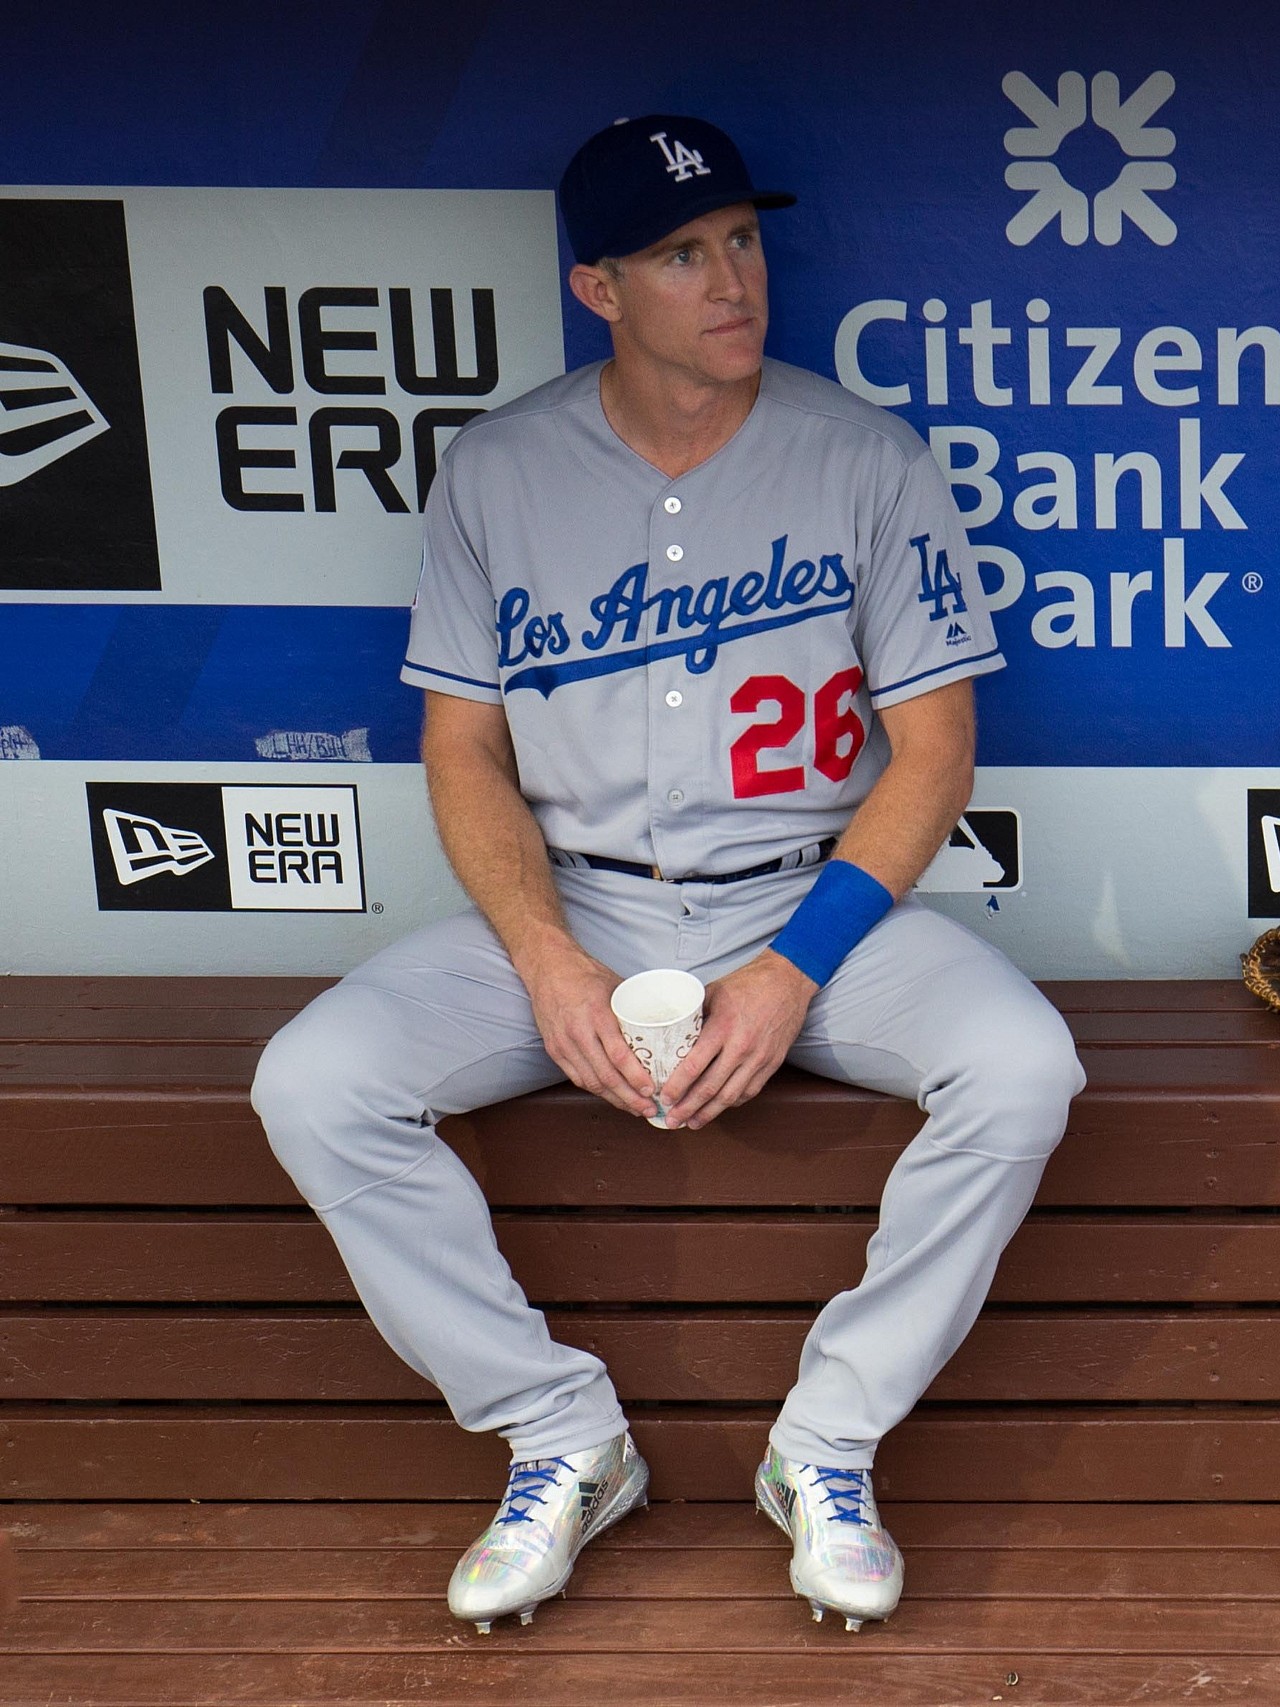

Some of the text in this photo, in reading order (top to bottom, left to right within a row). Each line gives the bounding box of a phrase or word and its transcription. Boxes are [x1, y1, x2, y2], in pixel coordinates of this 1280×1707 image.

[649, 131, 711, 182] LA
[202, 285, 500, 396] NEW
[928, 417, 1249, 531] Bank
[495, 533, 856, 675] Los Angeles
[908, 532, 968, 622] LA
[729, 664, 866, 800] 26
[244, 812, 341, 848] NEW
[248, 849, 344, 885] ERA
[582, 1479, 609, 1534] adidas
